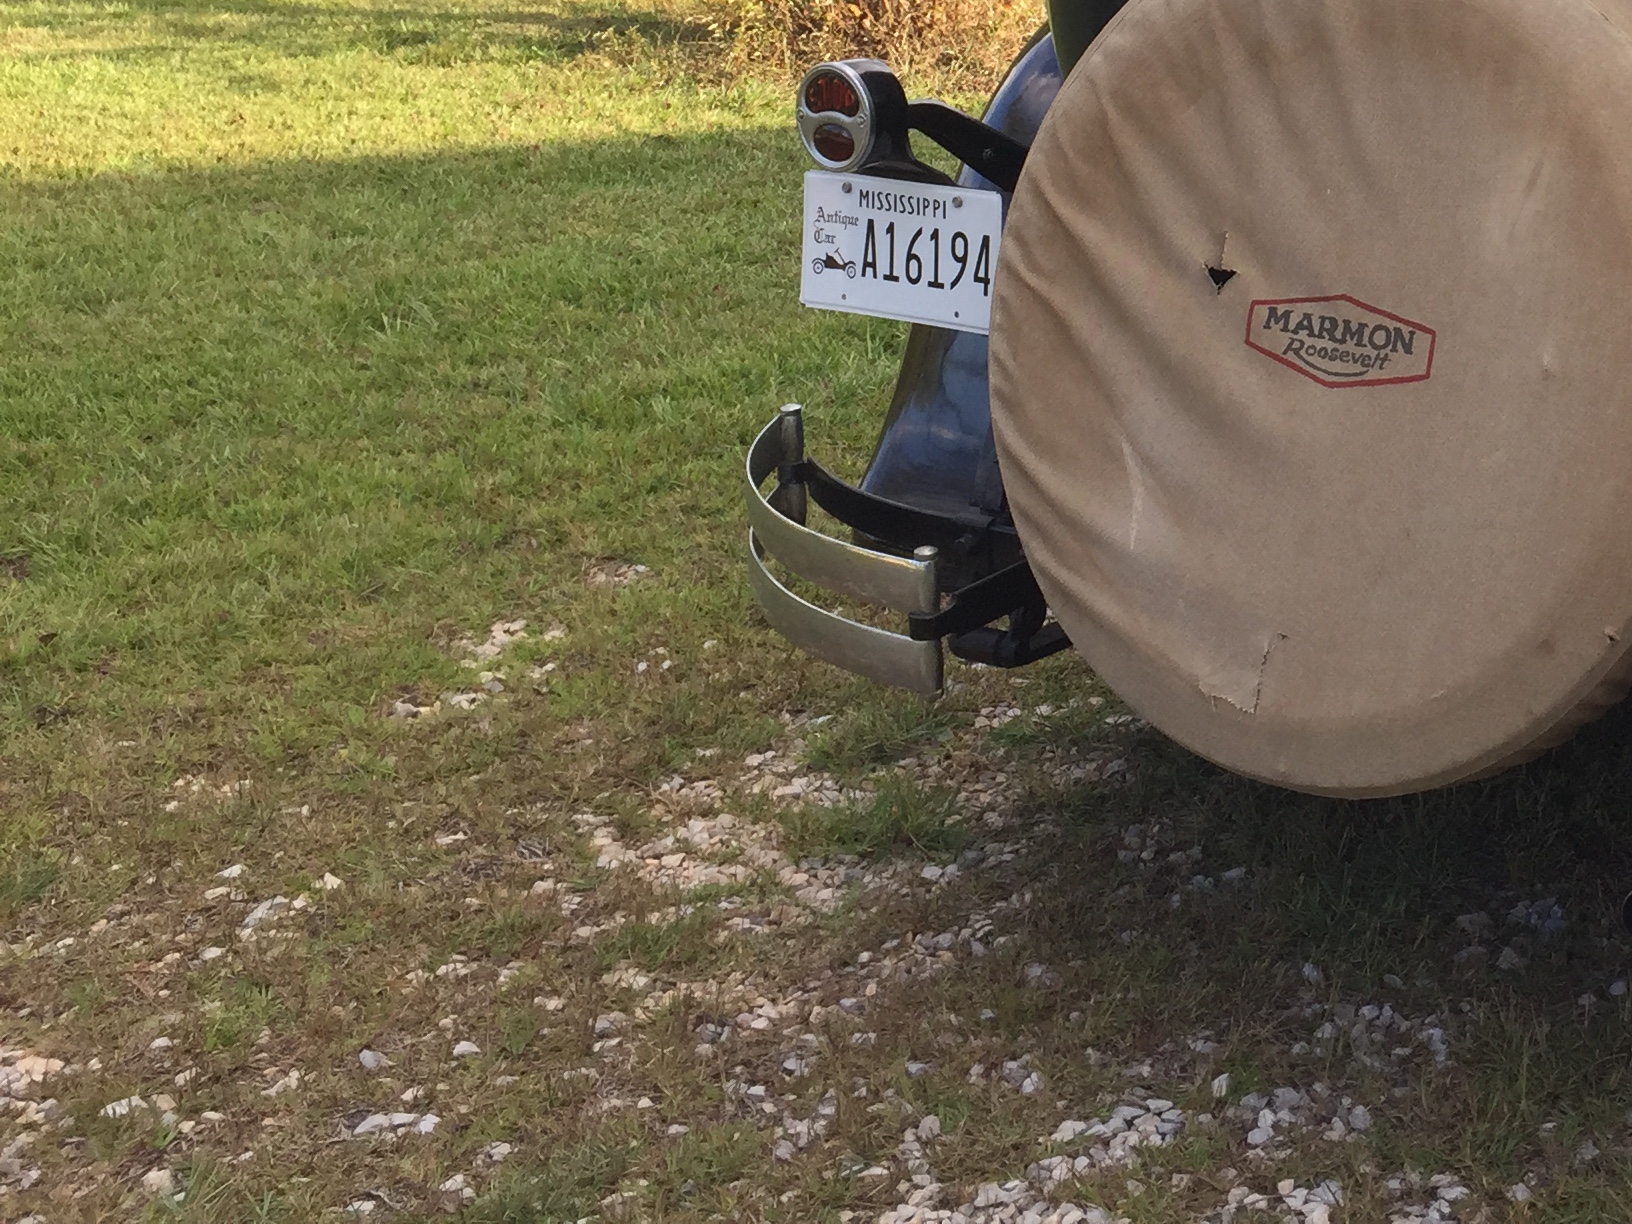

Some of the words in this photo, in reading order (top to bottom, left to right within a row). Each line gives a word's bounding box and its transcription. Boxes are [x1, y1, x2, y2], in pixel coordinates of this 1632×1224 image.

[814, 206, 859, 231] Antique
[859, 189, 947, 219] MISSISSIPPI
[814, 229, 836, 245] Car
[861, 219, 991, 297] A16194
[1263, 307, 1417, 356] MARMON
[1283, 337, 1393, 377] Roosevelt
